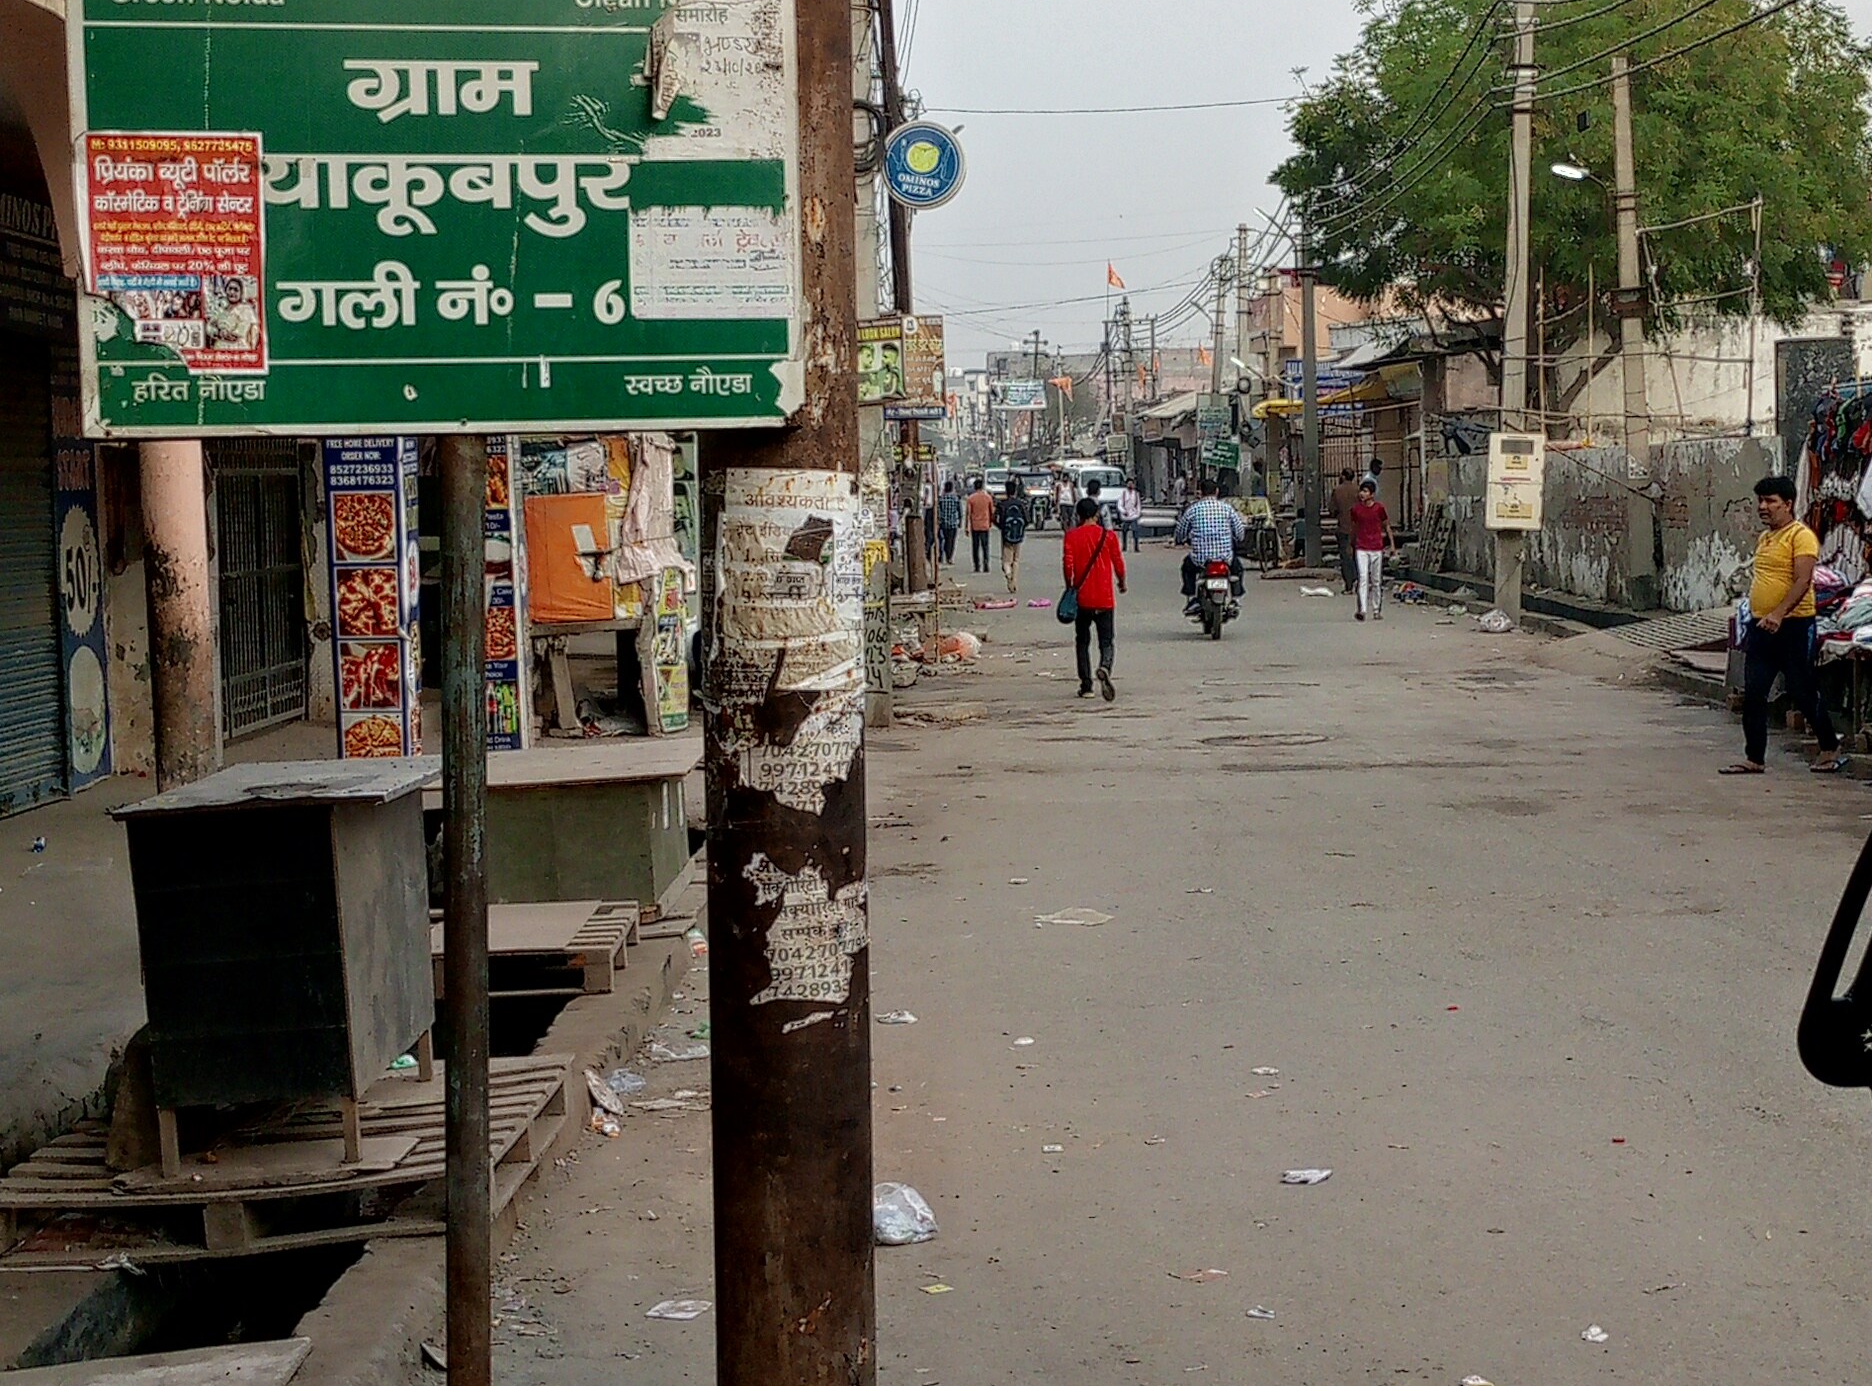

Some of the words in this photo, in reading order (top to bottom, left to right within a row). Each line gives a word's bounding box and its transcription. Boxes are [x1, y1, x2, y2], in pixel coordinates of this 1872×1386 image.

[343, 59, 540, 123] ग्राम
[95, 154, 154, 185] प्रियंका
[263, 154, 634, 239] याकूबपुर
[902, 183, 933, 197] PIZZA
[188, 260, 215, 271] 20%
[276, 260, 421, 329] गली
[593, 278, 627, 326] 6
[131, 371, 192, 404] हरित
[624, 373, 684, 397] स्वच्छ
[689, 370, 754, 396] नौएडा
